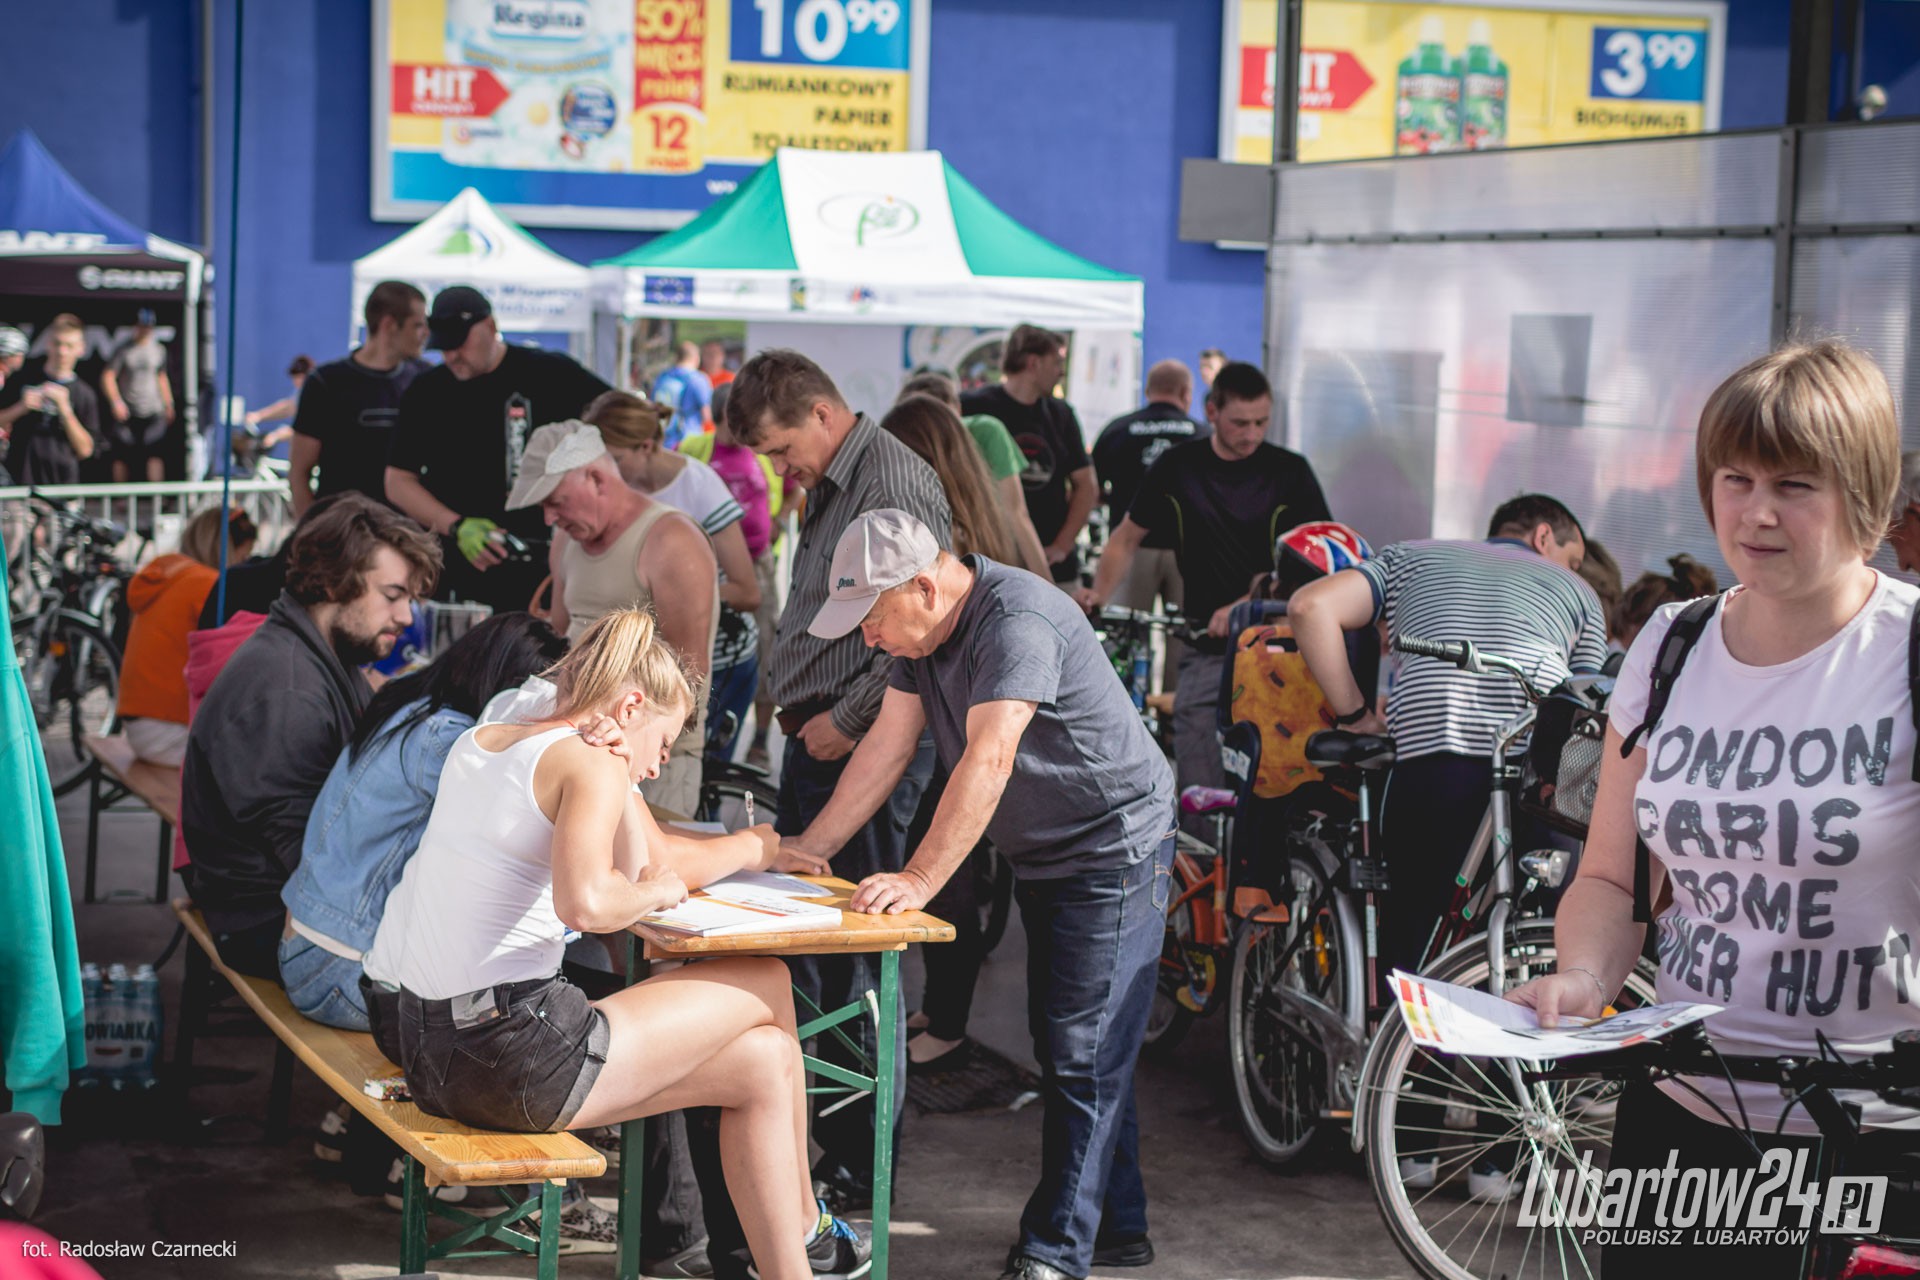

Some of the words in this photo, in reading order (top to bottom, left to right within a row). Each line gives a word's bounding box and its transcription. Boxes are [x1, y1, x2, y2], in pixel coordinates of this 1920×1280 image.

[494, 5, 587, 29] Regina
[413, 67, 476, 99] HIT
[722, 73, 893, 97] RUMIANKOWY
[1264, 52, 1337, 91] IT
[813, 107, 891, 126] PAPIER
[650, 115, 688, 150] 12
[103, 269, 184, 291] GIANT
[1650, 717, 1893, 791] ONDON
